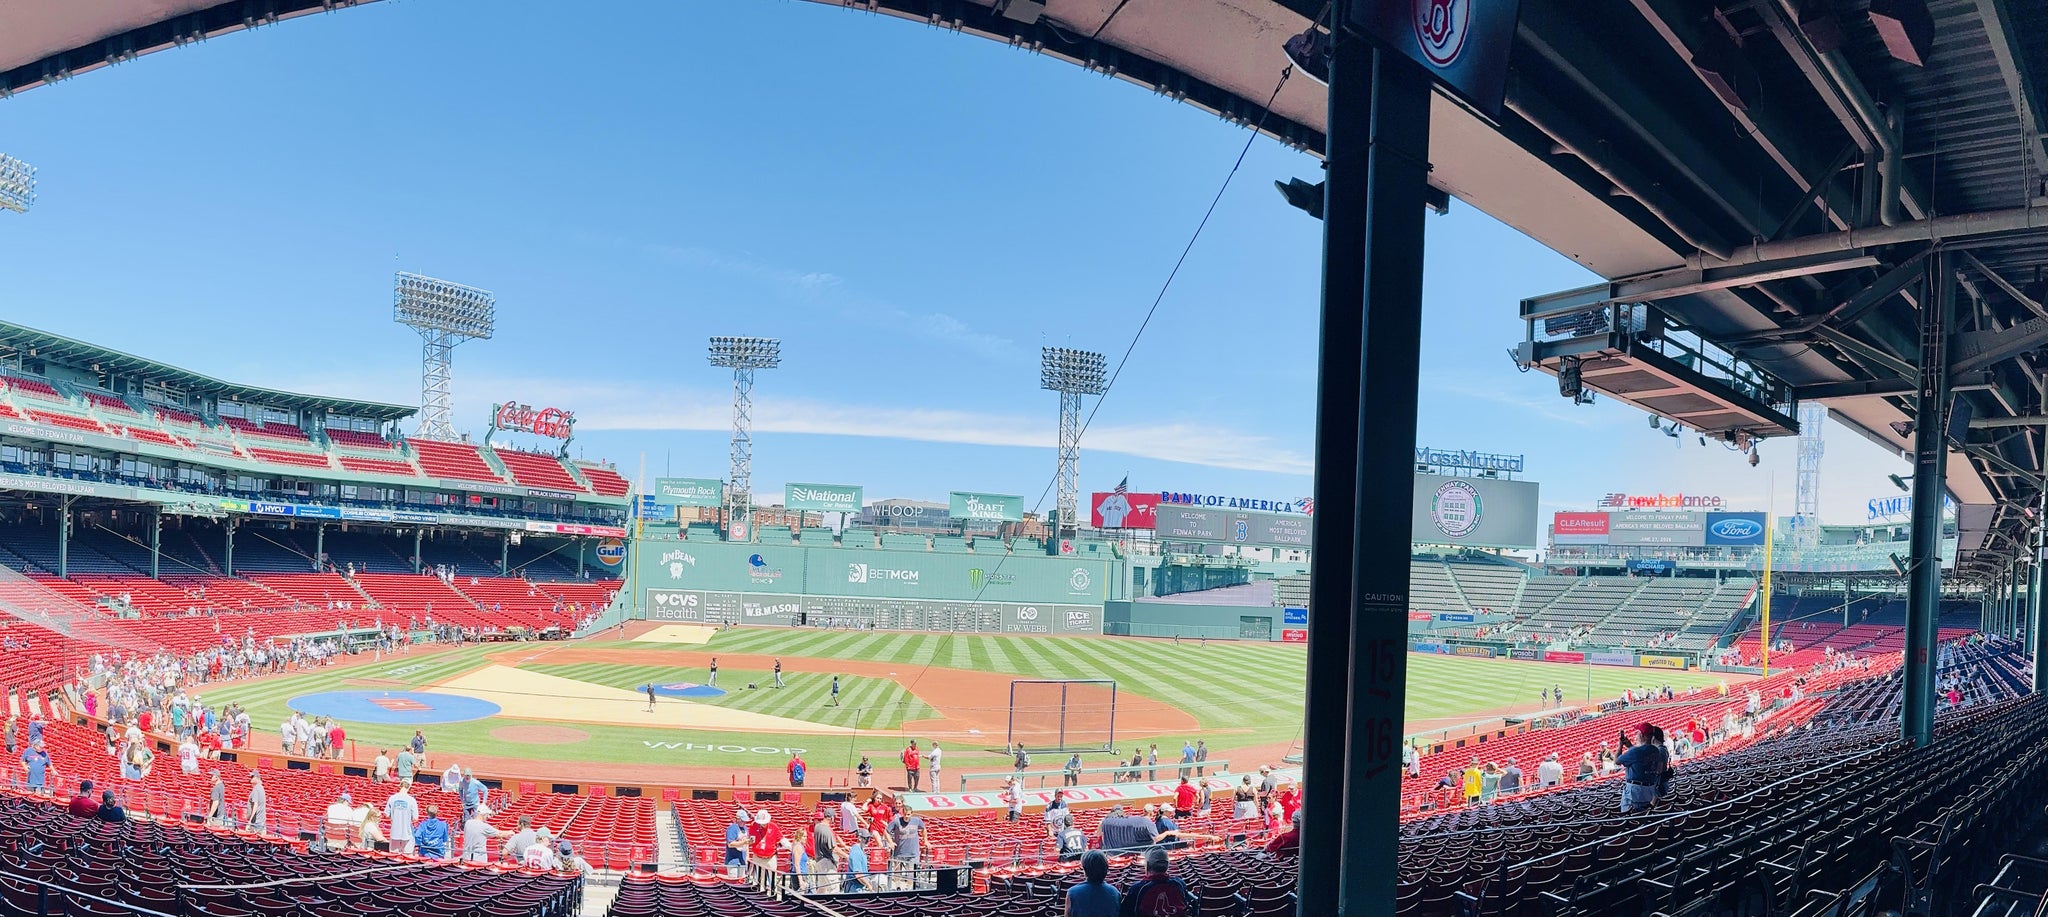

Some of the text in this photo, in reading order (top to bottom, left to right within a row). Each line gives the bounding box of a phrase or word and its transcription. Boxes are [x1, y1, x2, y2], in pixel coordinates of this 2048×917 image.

[8, 423, 35, 436] WELCOME
[45, 430, 68, 440] FENWAY
[69, 432, 85, 443] PARK
[1415, 447, 1523, 472] MassMutual
[25, 481, 40, 489] MOST
[41, 482, 66, 492] BELOVED
[67, 484, 95, 494] BALLPARK
[662, 485, 716, 496] Plymouth Rock
[1162, 491, 1292, 512] BANK OF AMERICA
[1628, 495, 1656, 507] new
[1659, 493, 1721, 507] balance
[265, 505, 284, 513] HYCU
[871, 505, 924, 518] WHOOP
[966, 503, 1005, 512] DRAFT
[971, 511, 1004, 519] KINGS
[1180, 512, 1207, 520] WELCOME
[1284, 528, 1307, 536] BELOVED
[1720, 523, 1752, 535] Ford
[597, 546, 625, 556] Gulf
[869, 569, 919, 580] BETMGM
[669, 594, 698, 606] CVS
[655, 606, 697, 619] Health
[1017, 606, 1038, 619] 160
[1068, 611, 1090, 620] ACE
[1024, 624, 1048, 632] WEBB
[1511, 650, 1535, 658] wasabi
[1369, 639, 1397, 686] 15
[1667, 659, 1676, 667] TEA
[1366, 717, 1393, 764] 16
[642, 741, 807, 755] WHOOP
[1067, 836, 1082, 849] 41
